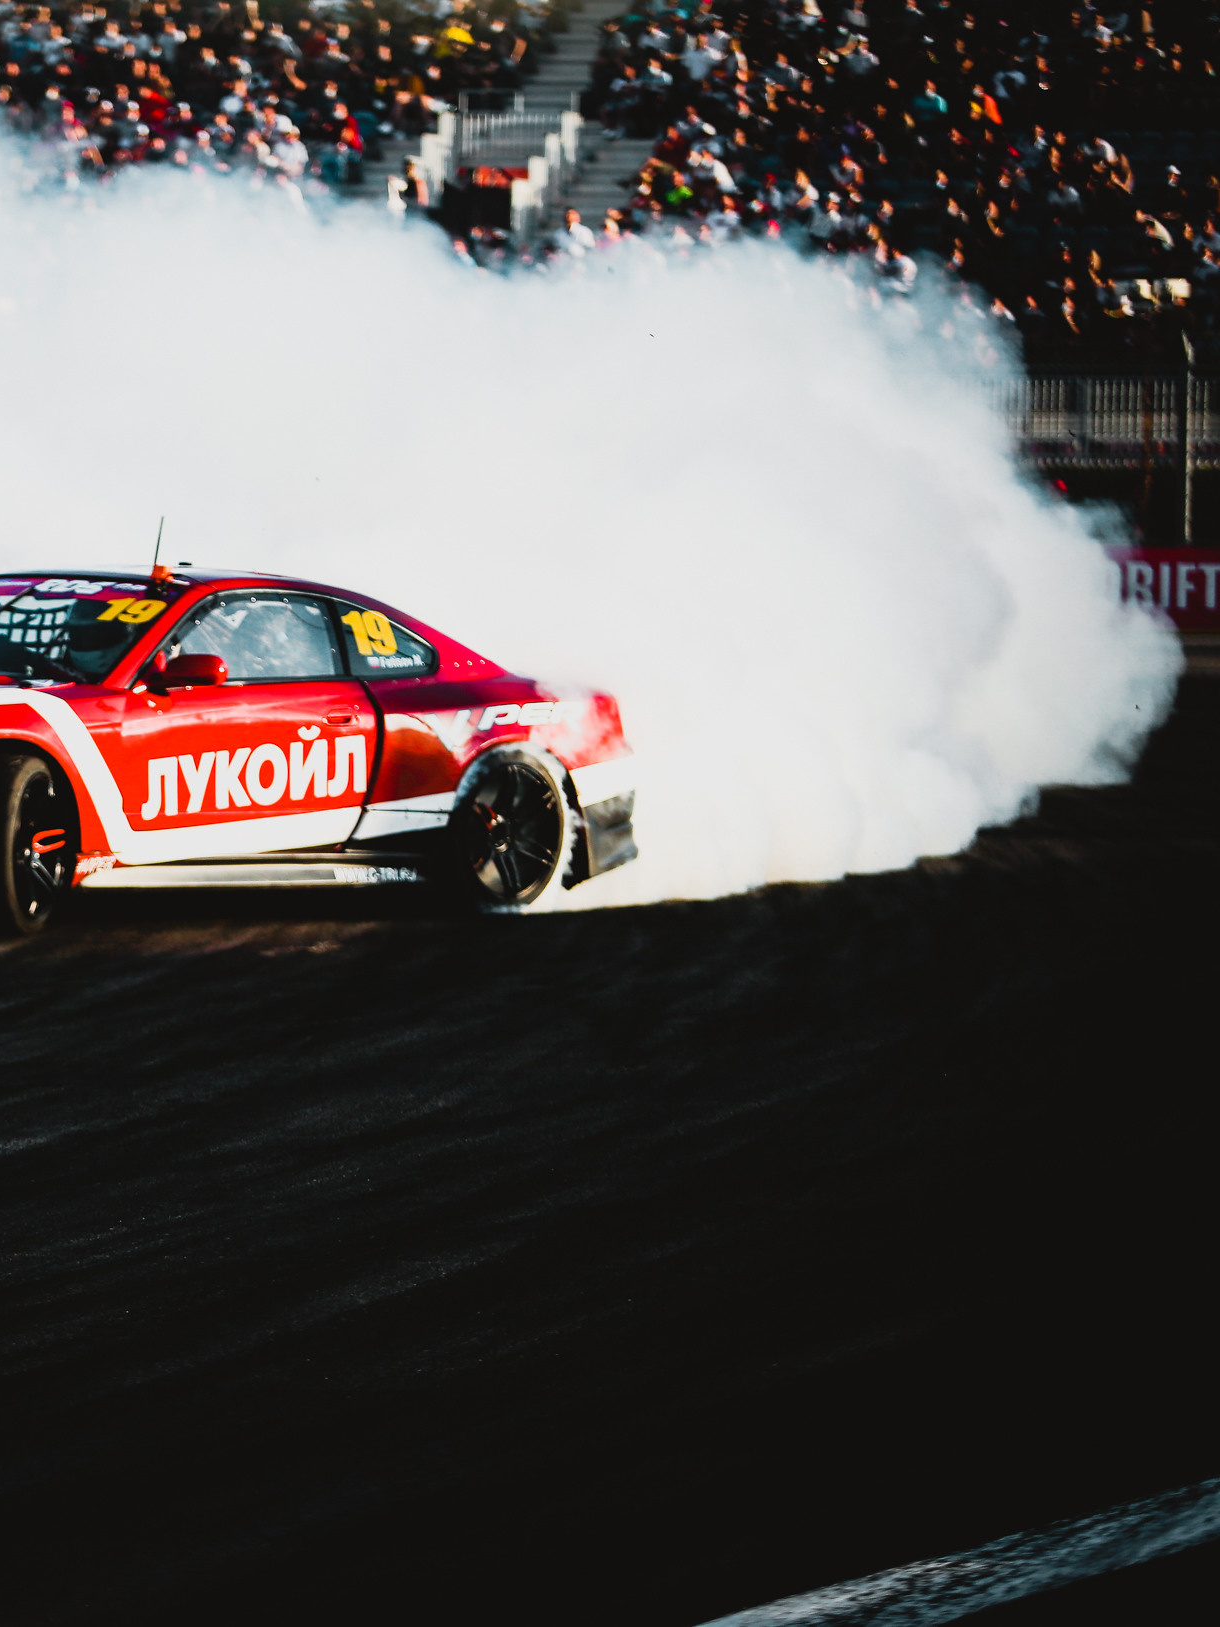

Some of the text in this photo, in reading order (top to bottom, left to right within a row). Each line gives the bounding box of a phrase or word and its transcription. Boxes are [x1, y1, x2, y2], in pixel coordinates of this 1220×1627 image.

[96, 598, 167, 624] 19
[341, 610, 398, 656] 19
[141, 725, 367, 821] ЛУКОЙЛ
